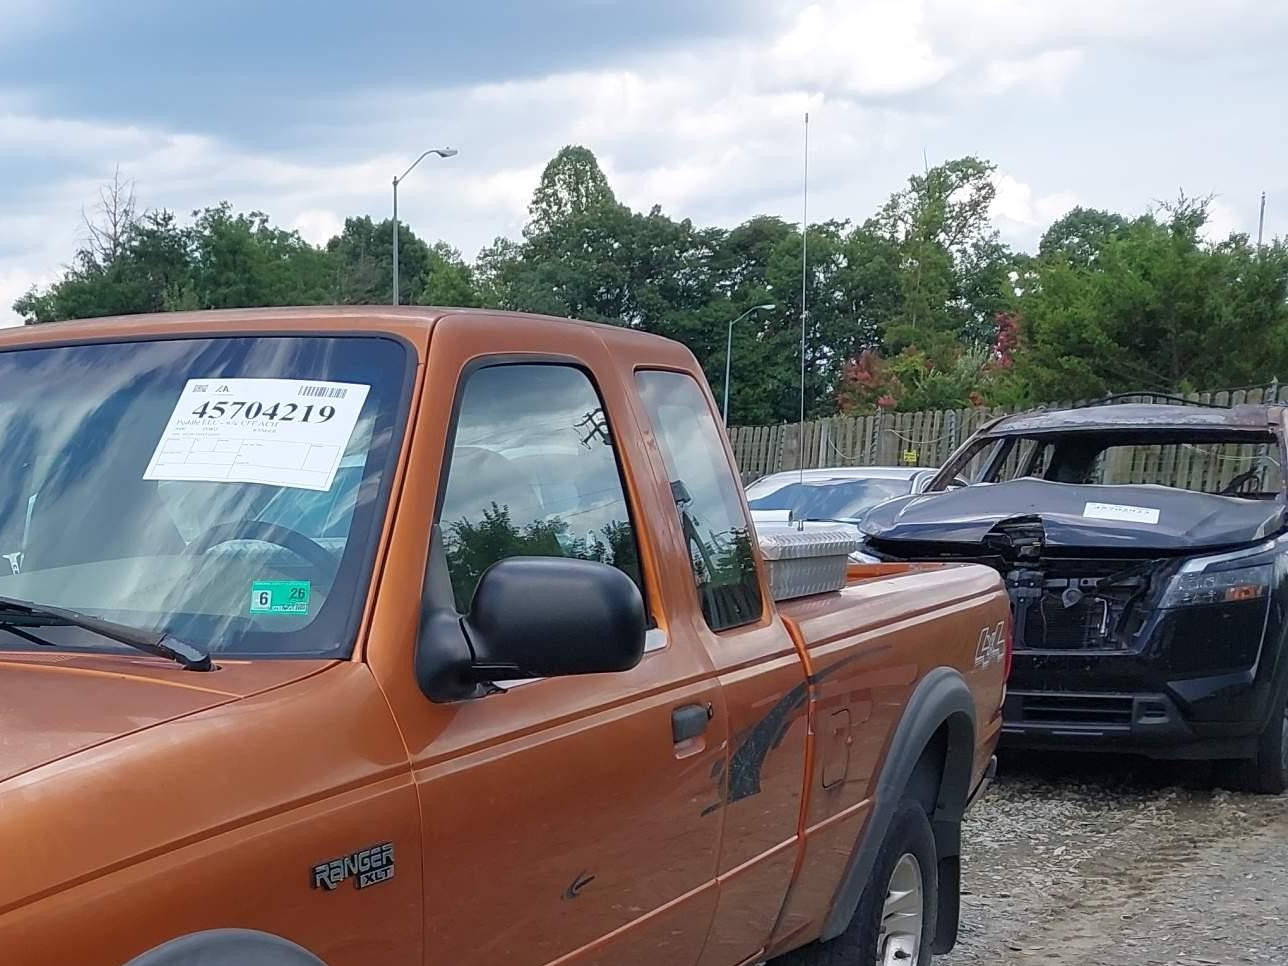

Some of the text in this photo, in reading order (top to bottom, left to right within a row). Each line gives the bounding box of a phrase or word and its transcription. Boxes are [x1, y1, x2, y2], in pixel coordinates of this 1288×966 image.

[191, 400, 337, 424] 45704219
[258, 591, 269, 606] 6
[289, 587, 306, 600] 26
[364, 866, 392, 886] XLT
